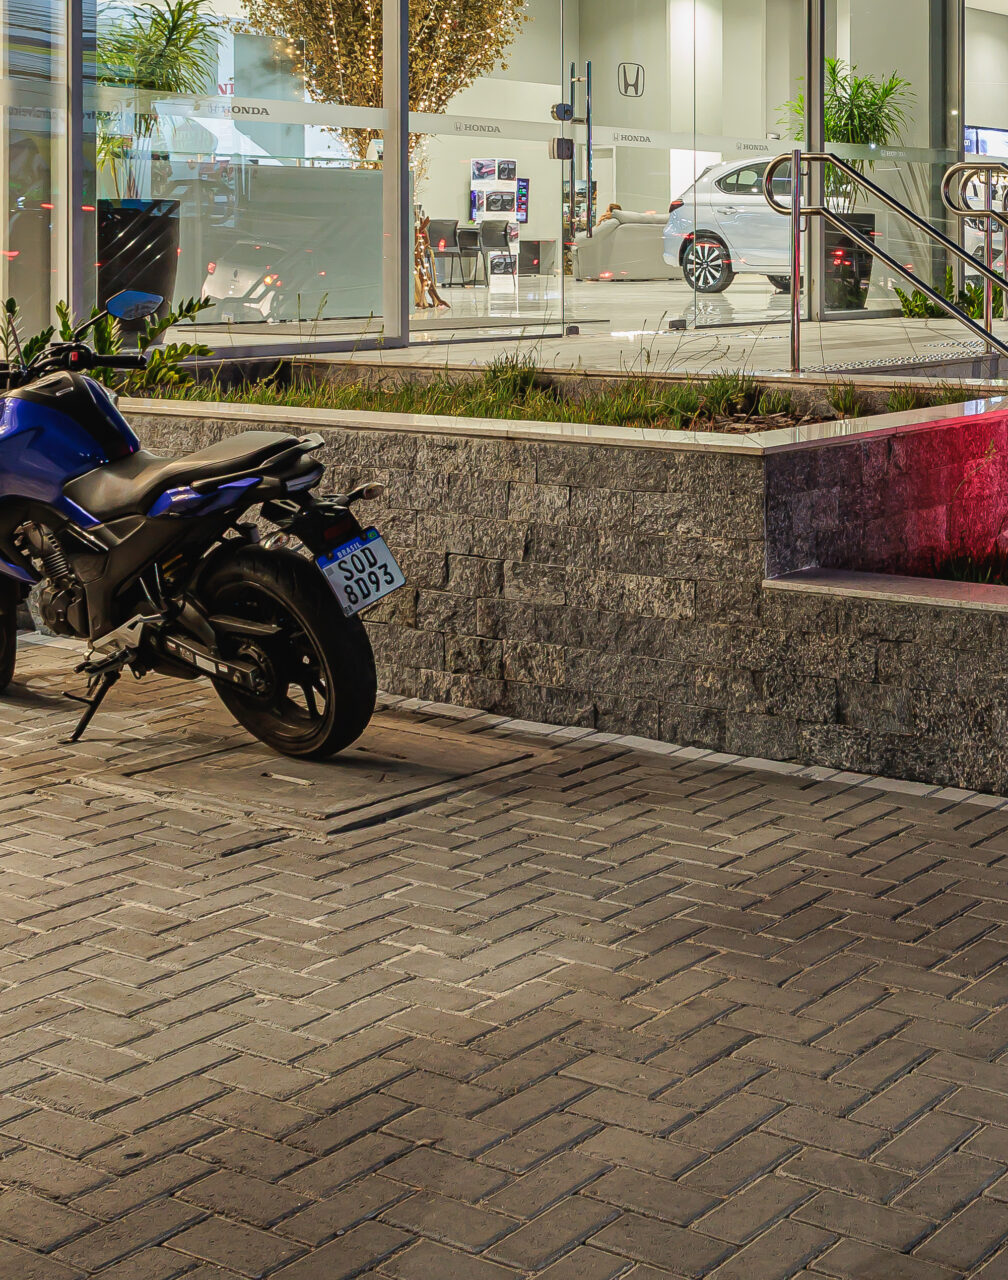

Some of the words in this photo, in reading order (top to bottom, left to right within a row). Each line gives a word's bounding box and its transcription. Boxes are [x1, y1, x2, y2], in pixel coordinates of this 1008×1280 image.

[464, 124, 501, 133] HONDA
[620, 134, 651, 143] HONDA
[336, 541, 362, 559] BRASIL
[338, 546, 378, 582] SOD
[344, 563, 395, 605] 8D93
